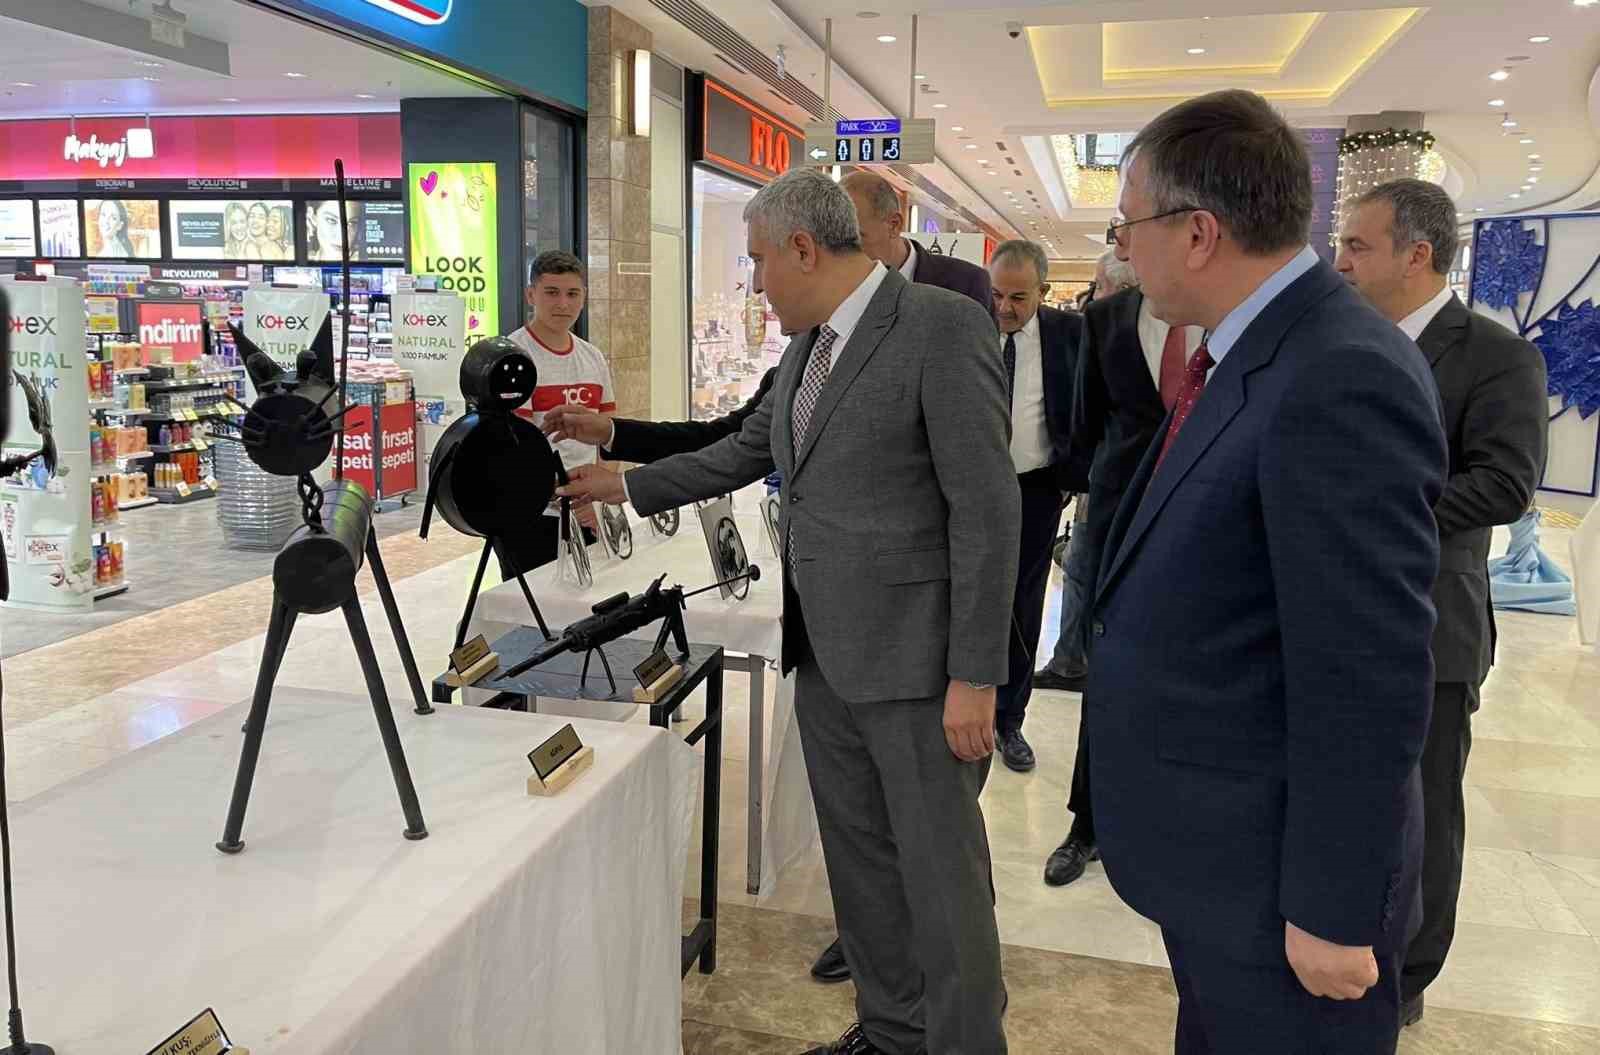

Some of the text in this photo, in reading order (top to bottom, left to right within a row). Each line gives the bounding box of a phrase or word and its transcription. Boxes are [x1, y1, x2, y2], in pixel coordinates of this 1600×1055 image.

[64, 134, 126, 168] Makyaj
[751, 117, 790, 176] FLO
[320, 179, 381, 187] MAYELLINE
[426, 256, 483, 273] LOOK
[162, 269, 218, 279] REVOLUTION
[441, 276, 485, 292] OOD
[398, 335, 456, 349] NATURAL
[418, 352, 448, 361] PAMUK
[382, 447, 414, 469] sepeti
